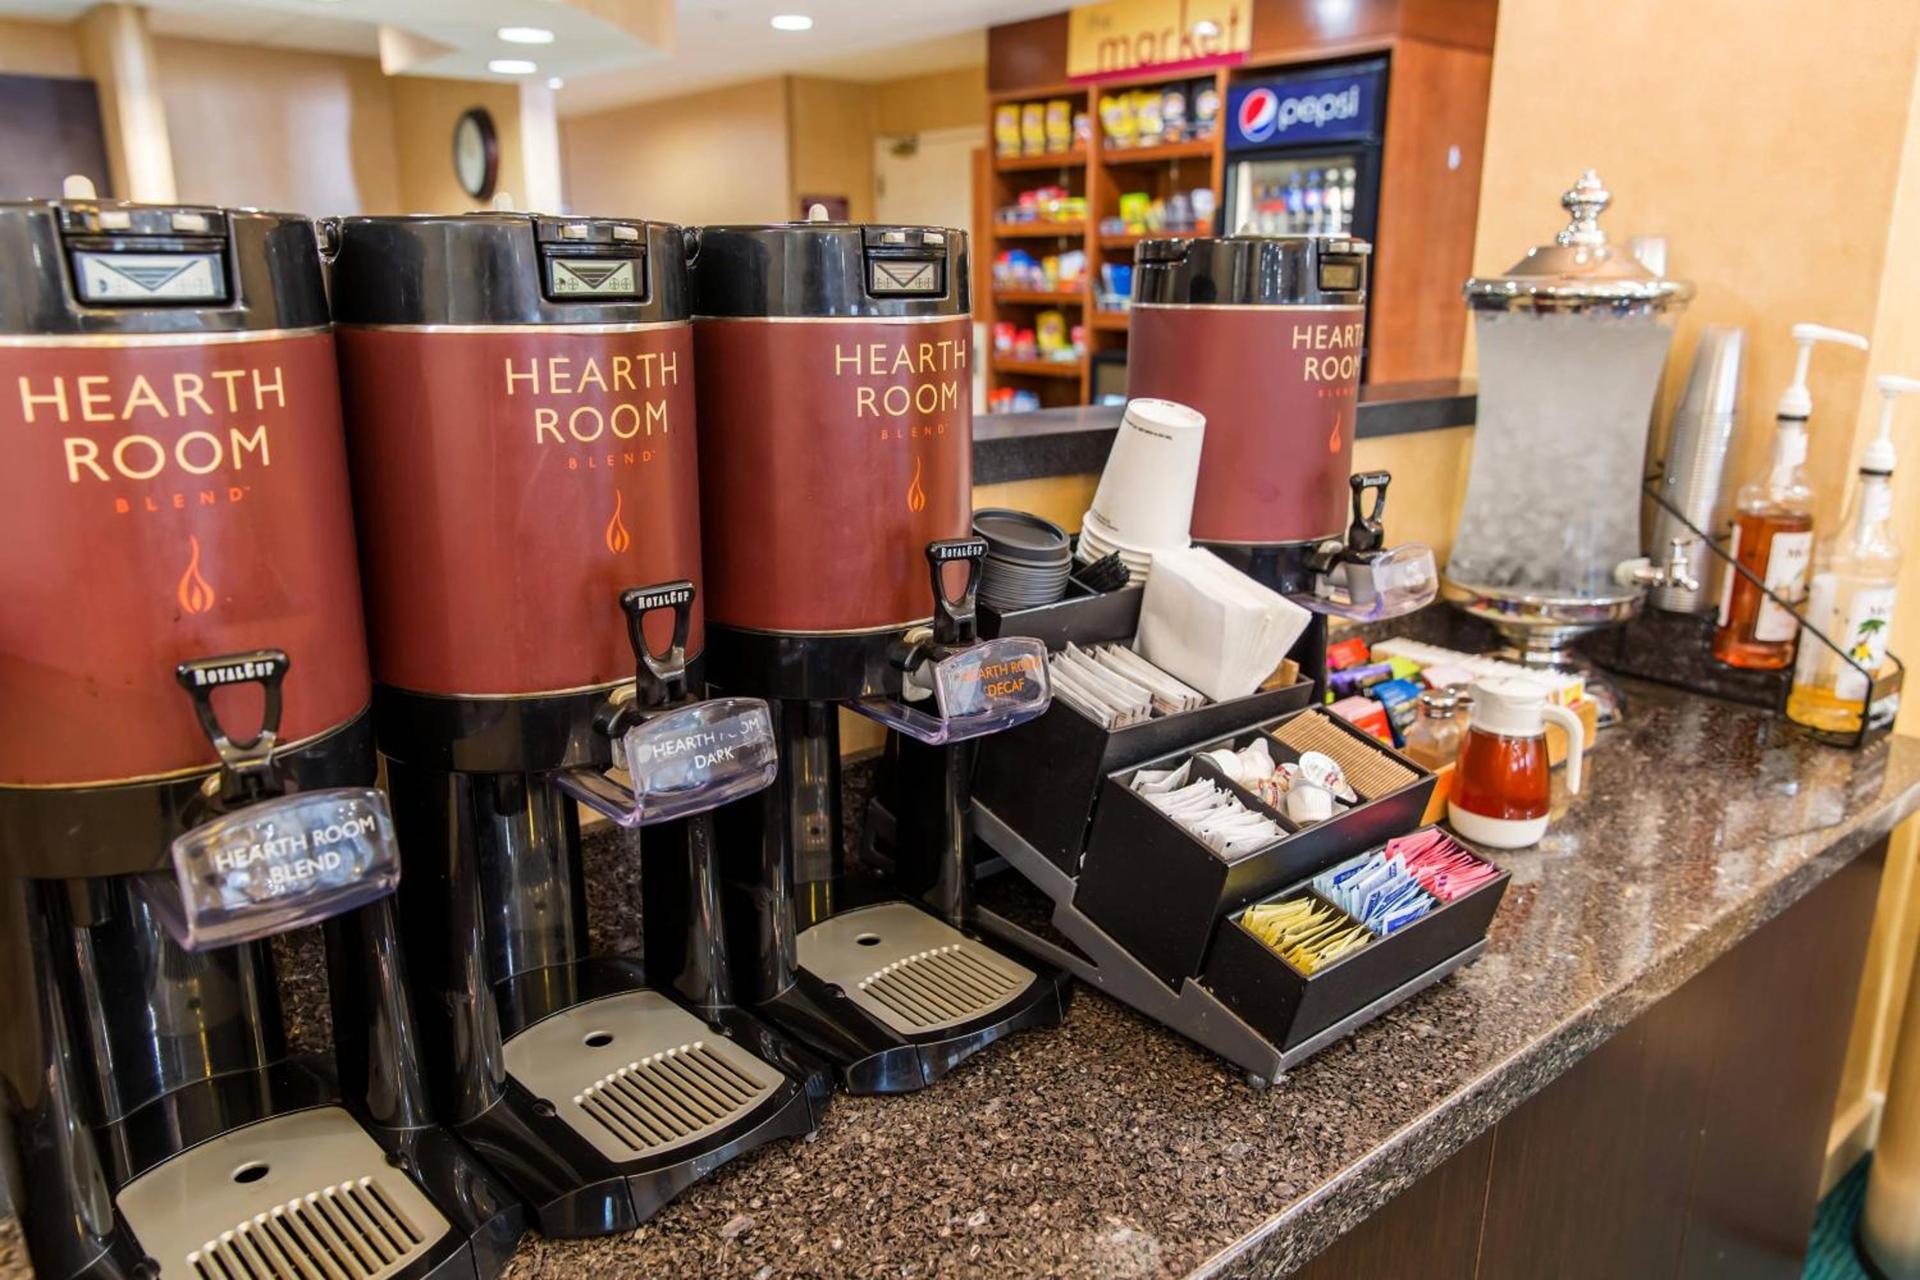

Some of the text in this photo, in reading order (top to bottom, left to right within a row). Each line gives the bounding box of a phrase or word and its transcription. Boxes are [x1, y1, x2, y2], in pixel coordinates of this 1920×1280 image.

[1278, 84, 1360, 131] pepsi
[1292, 323, 1364, 349] HEART
[505, 351, 677, 395] HEARTH
[835, 339, 966, 376] HEARTH
[18, 366, 286, 423] HEARTH
[857, 381, 957, 418] ROOM
[535, 399, 668, 444] ROOM
[63, 425, 271, 483] ROOM
[957, 661, 1008, 682] ARTH
[986, 678, 1025, 698] DECAF
[652, 717, 761, 759] HEARTH OM
[694, 746, 735, 769] DARK
[215, 815, 376, 872] HEARTH ROOM
[269, 851, 341, 886] BLEND
